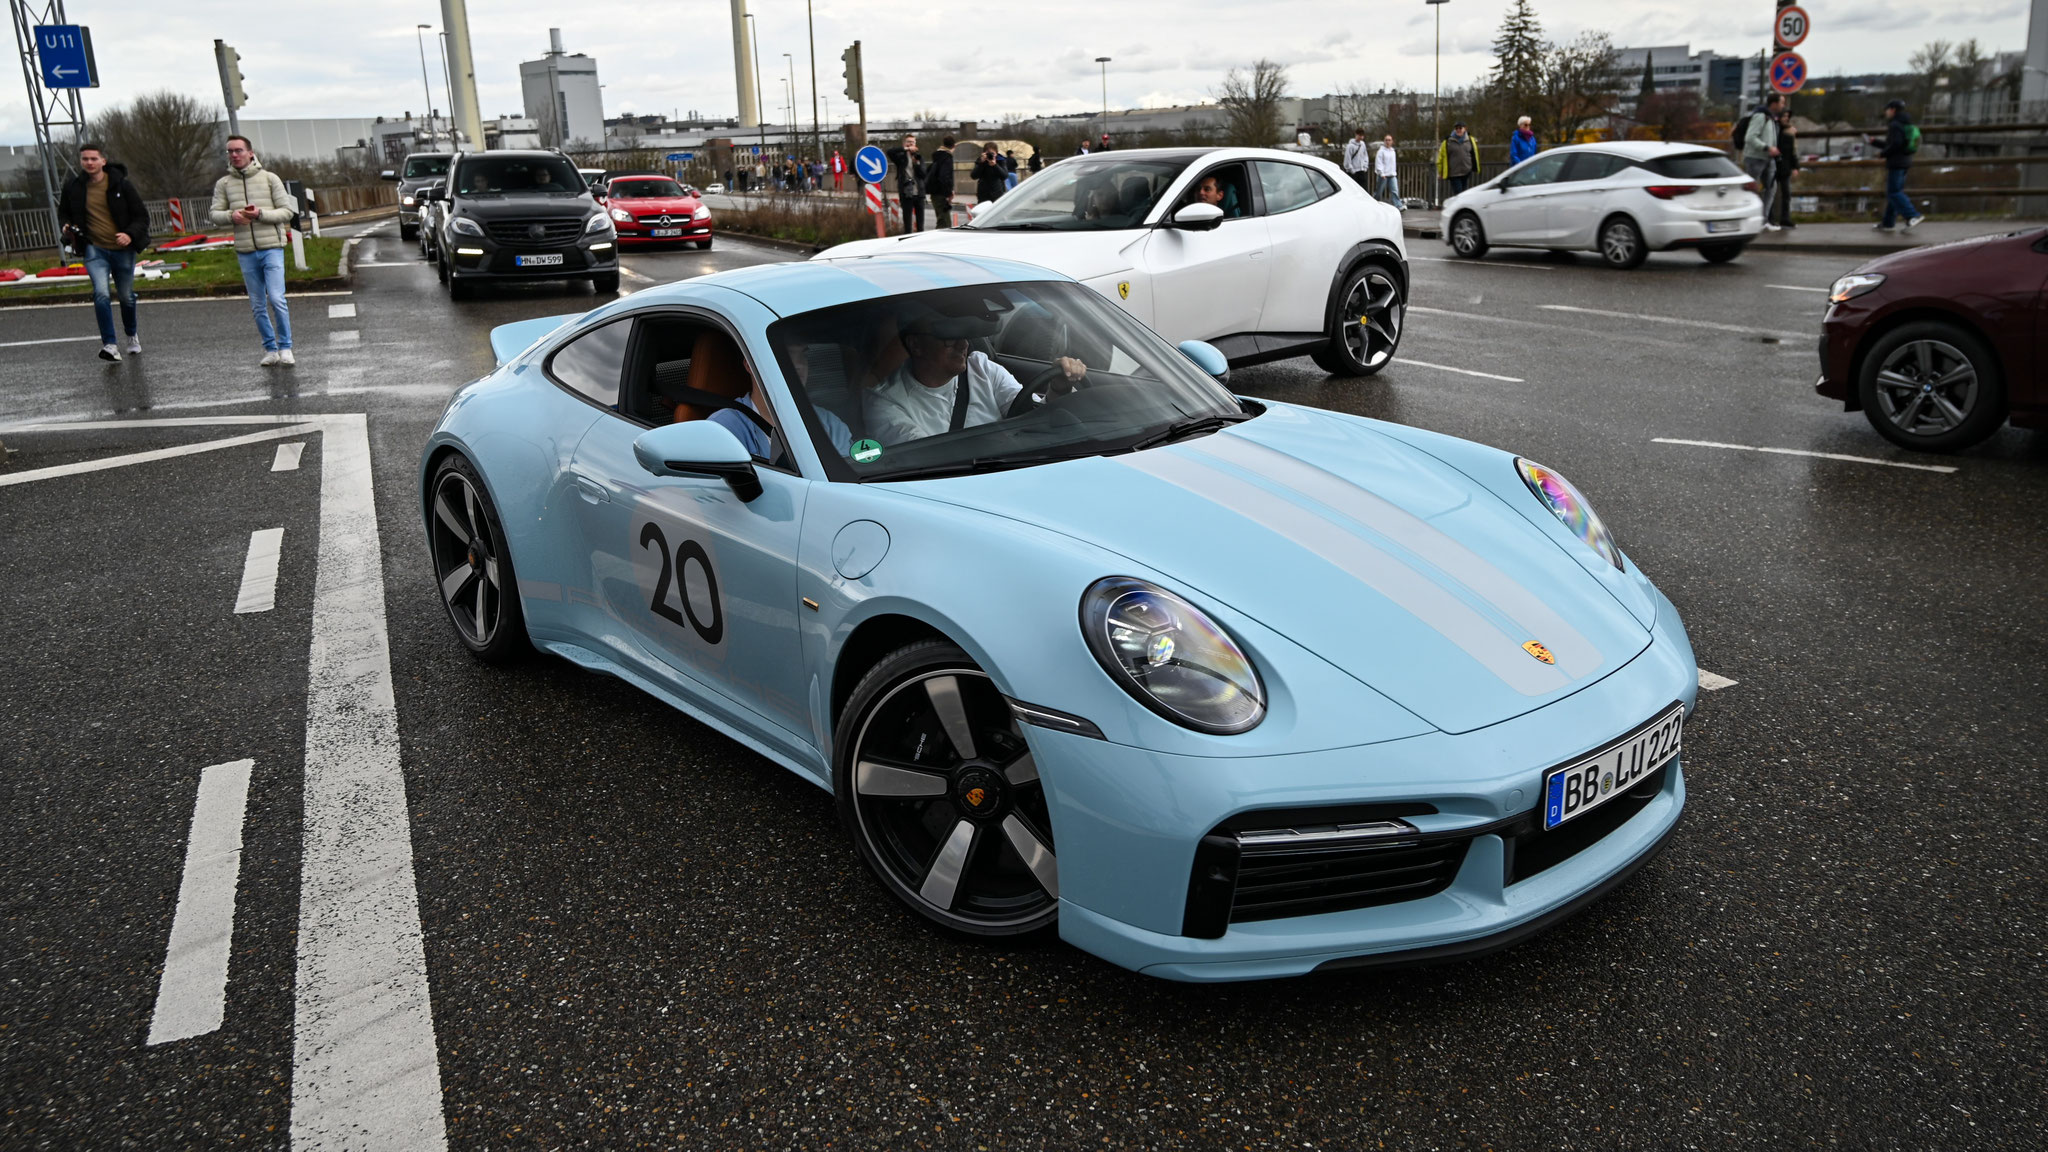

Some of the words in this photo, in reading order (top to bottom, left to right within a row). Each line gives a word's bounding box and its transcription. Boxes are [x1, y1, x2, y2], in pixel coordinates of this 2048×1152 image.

[1783, 17, 1803, 36] 50
[536, 256, 546, 264] DW
[547, 255, 561, 263] 599
[860, 439, 870, 450] 4
[640, 521, 723, 645] 20
[913, 733, 927, 761] SCHE
[1552, 806, 1558, 817] D
[1564, 764, 1600, 815] BB
[1615, 739, 1646, 790] LU
[1647, 714, 1681, 771] 222
